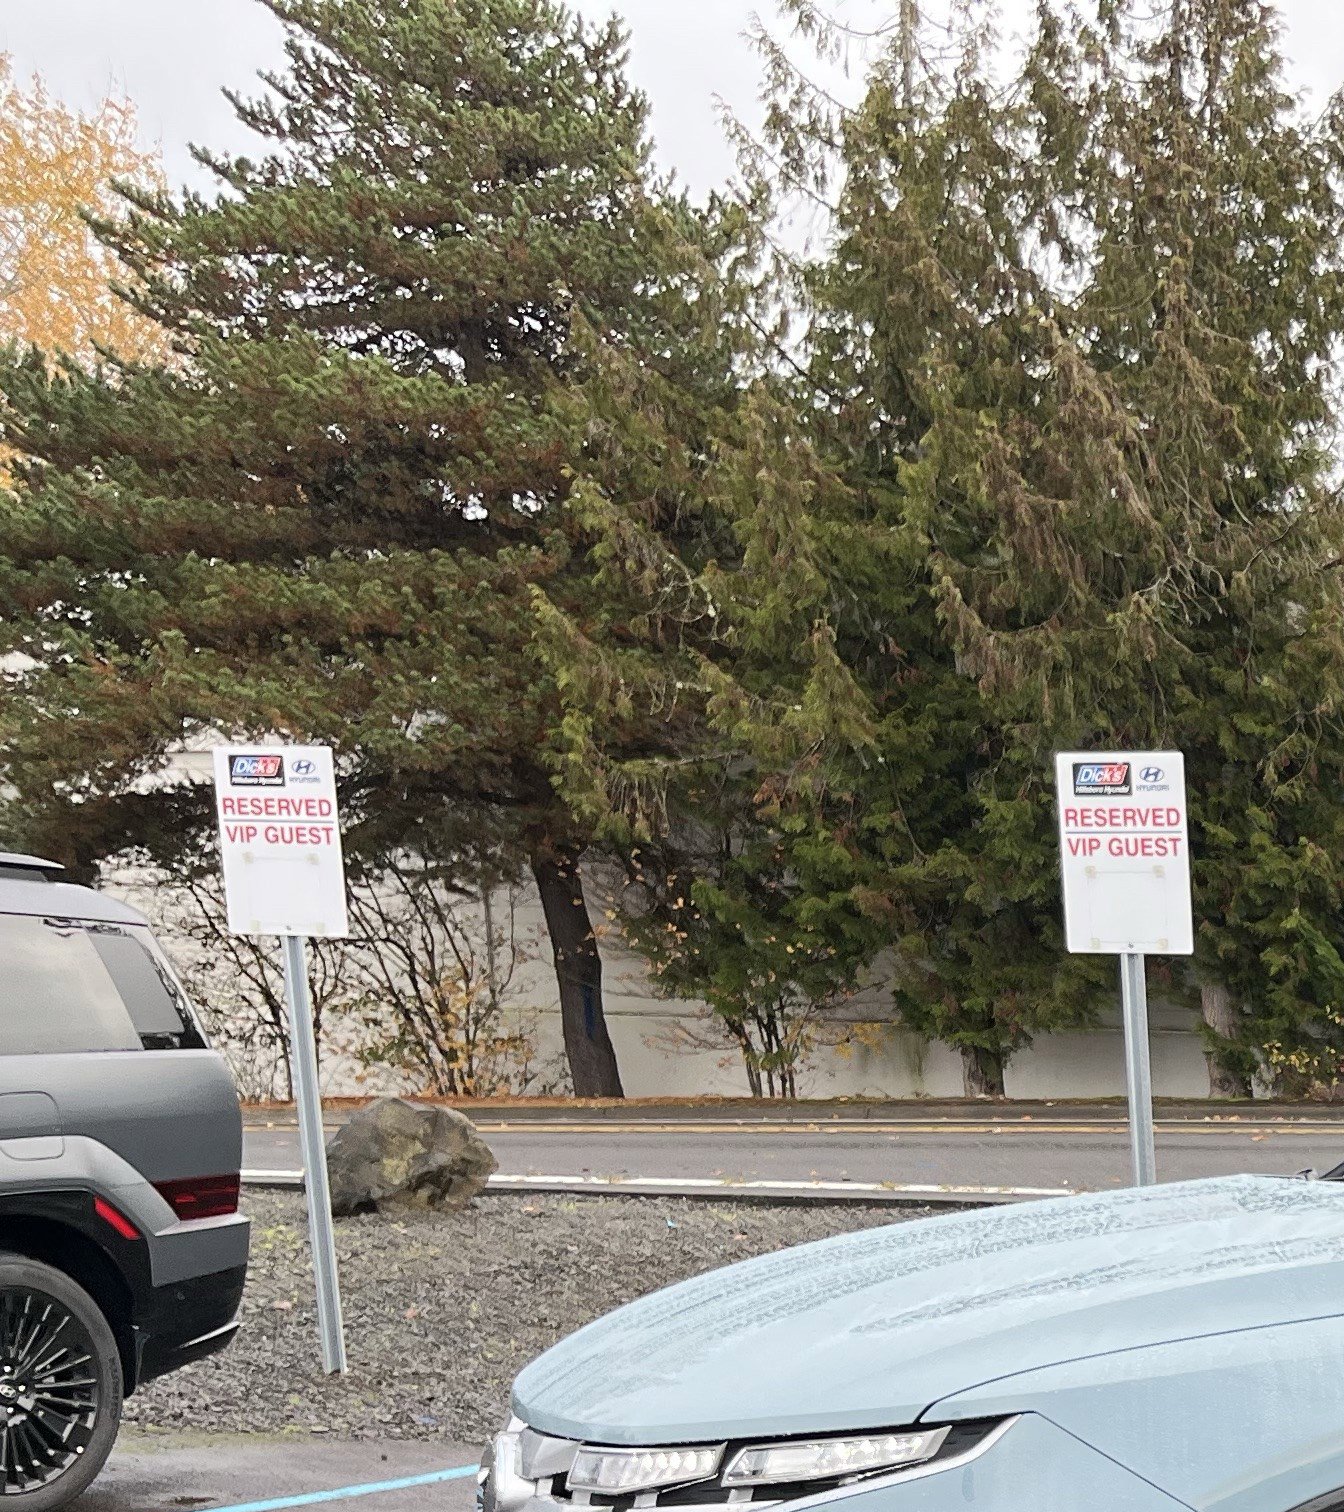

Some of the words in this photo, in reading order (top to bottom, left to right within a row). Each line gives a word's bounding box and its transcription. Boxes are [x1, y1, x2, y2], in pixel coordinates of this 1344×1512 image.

[222, 797, 332, 817] RESERVED
[1064, 807, 1181, 828] RESERVED
[225, 825, 258, 844] VIP
[265, 825, 334, 845] GUEST
[1067, 838, 1101, 857] VIP
[1108, 837, 1182, 857] GUEST
